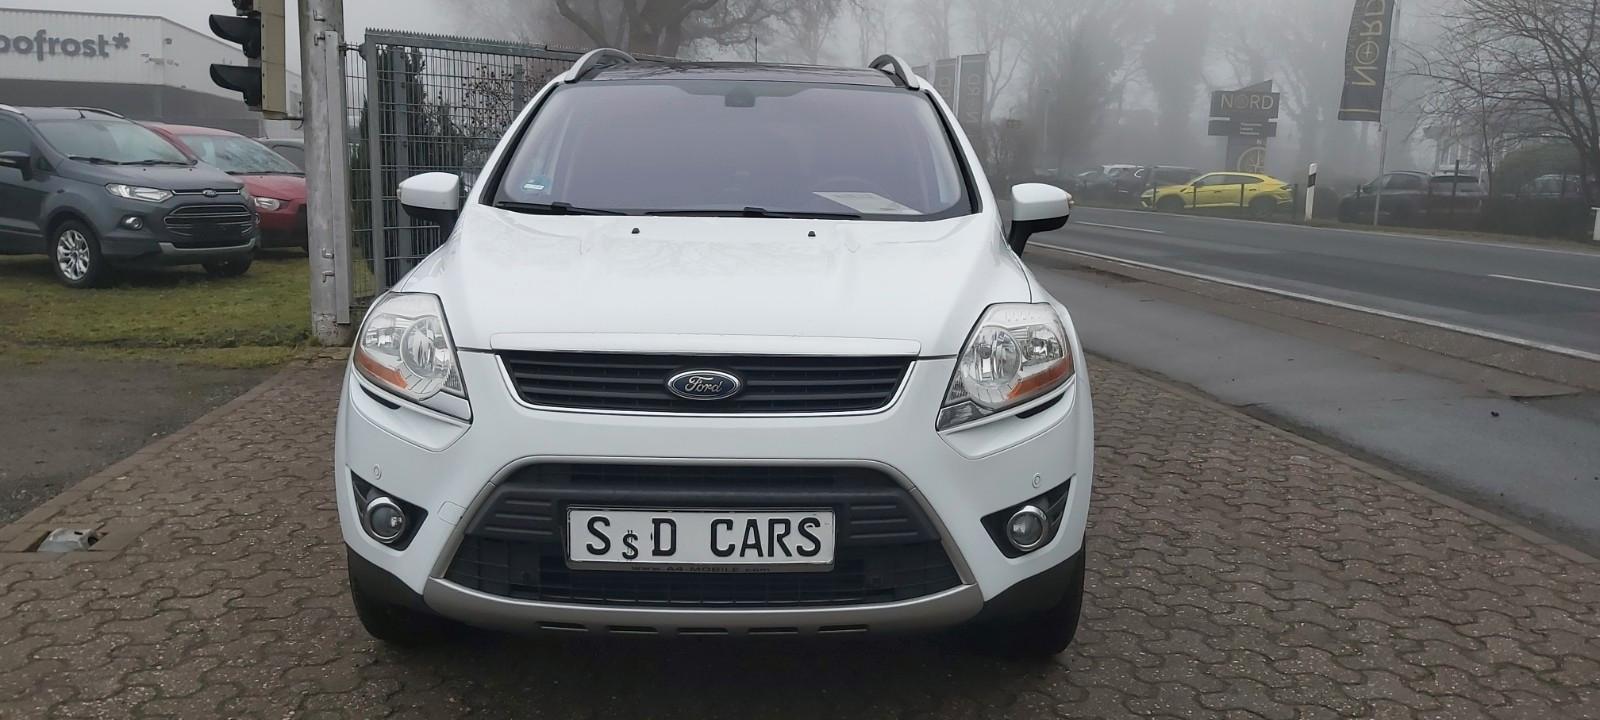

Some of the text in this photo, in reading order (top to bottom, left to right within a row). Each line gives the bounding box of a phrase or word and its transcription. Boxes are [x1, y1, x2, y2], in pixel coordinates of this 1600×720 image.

[1221, 94, 1274, 110] NORD
[685, 376, 723, 392] Ford
[710, 516, 822, 558] CARS
